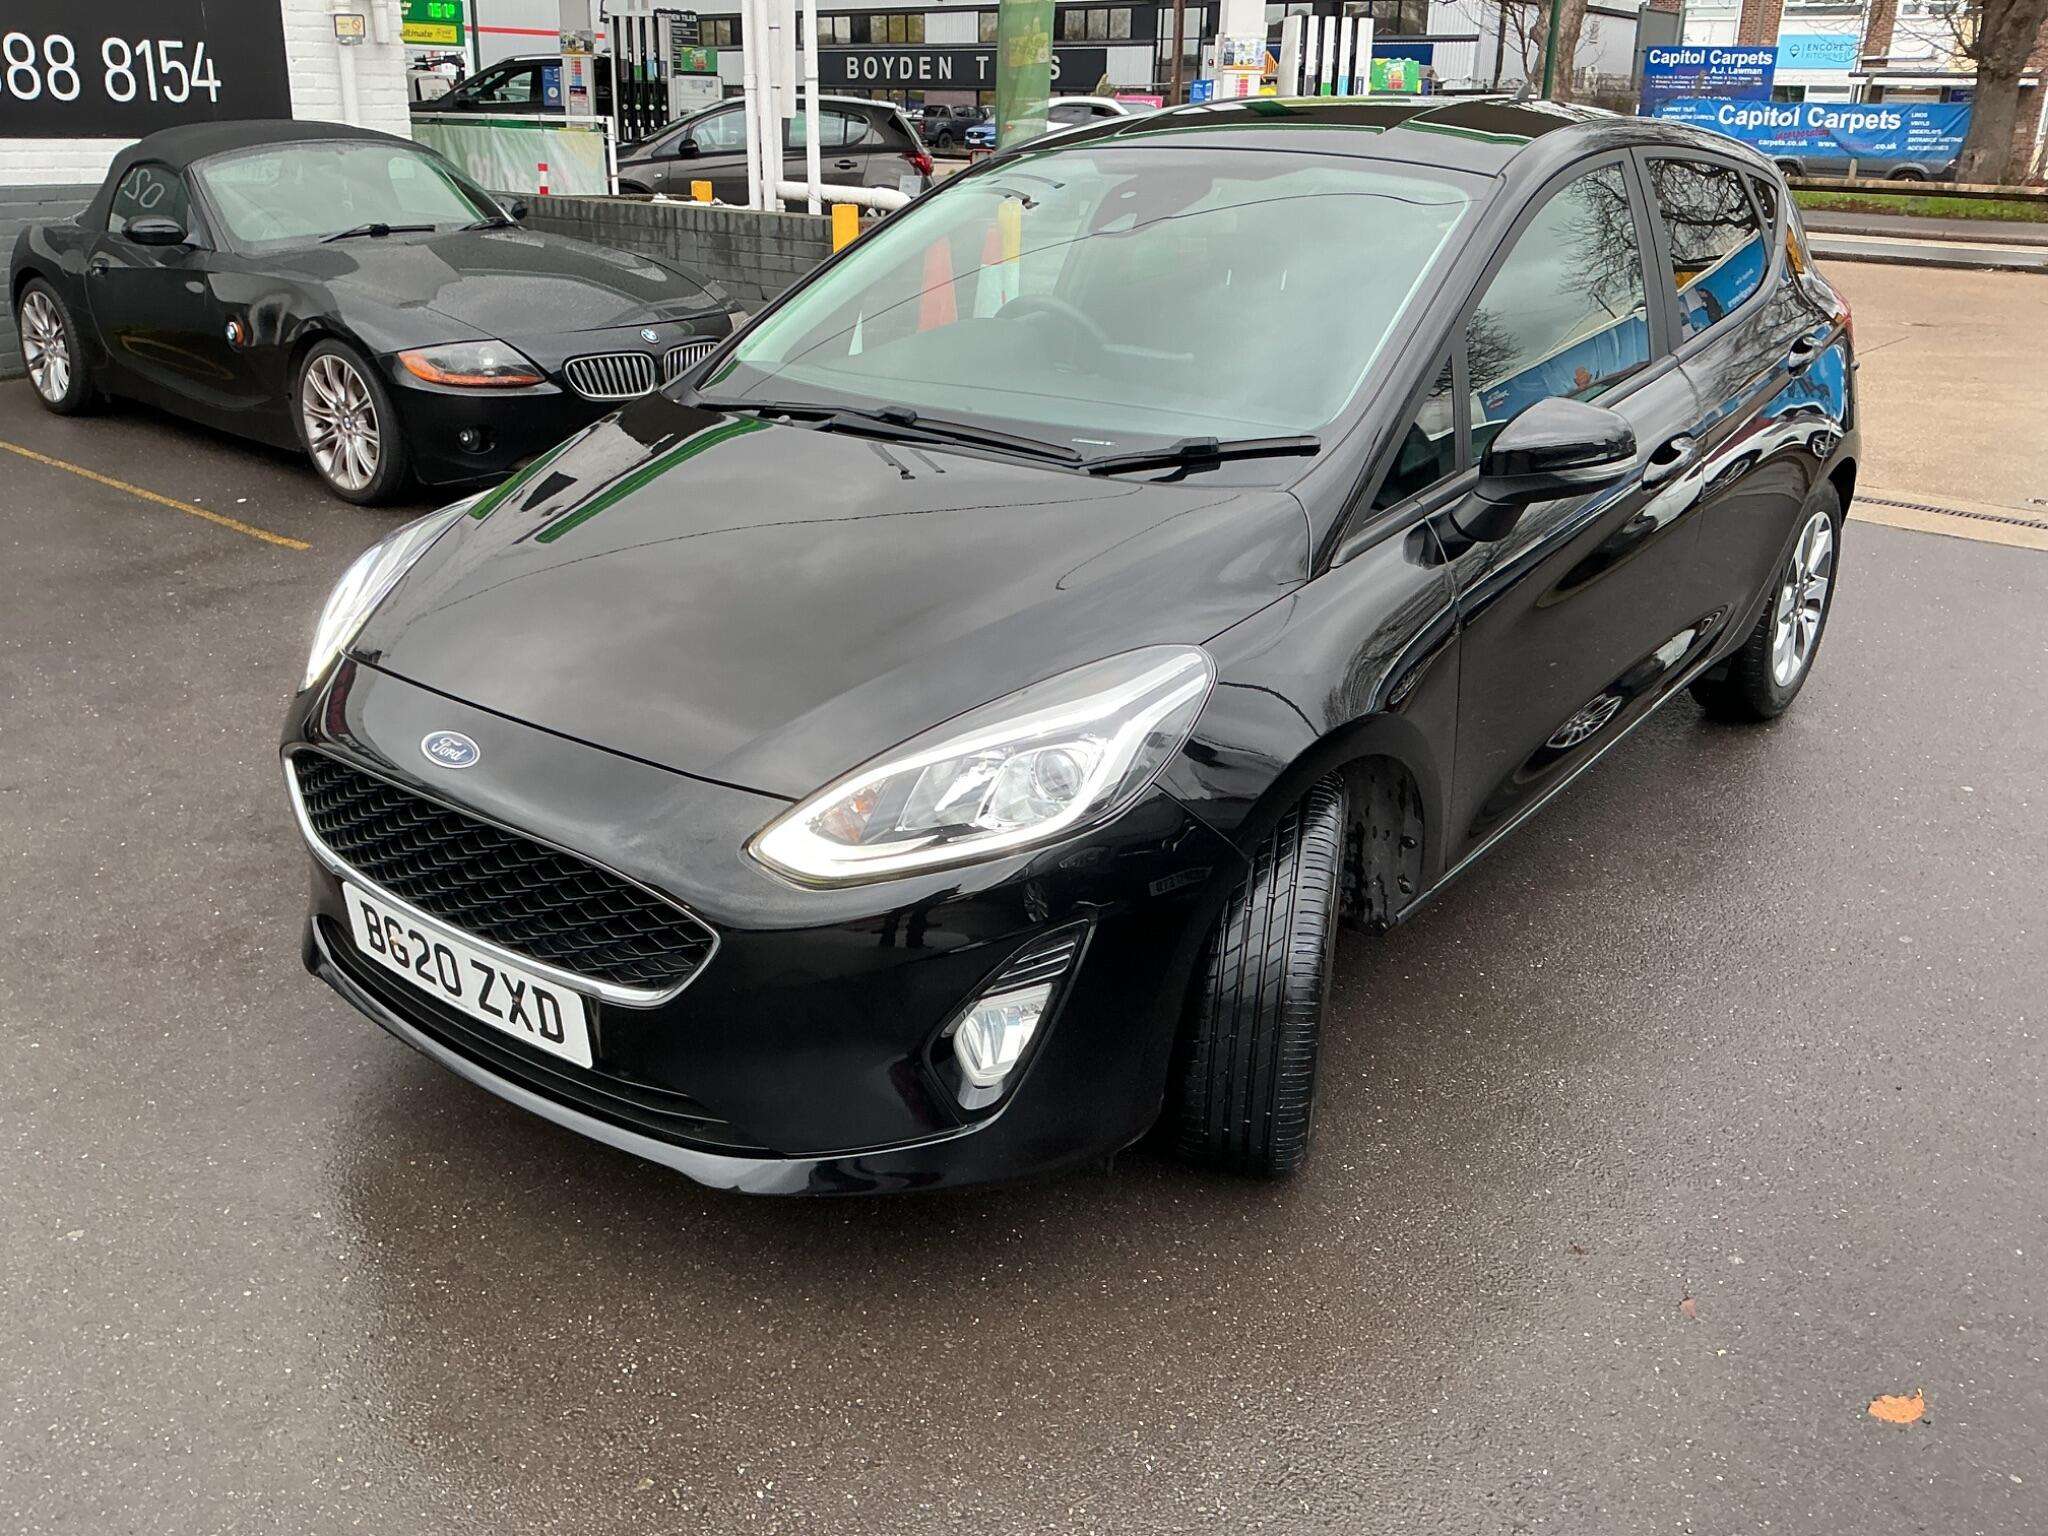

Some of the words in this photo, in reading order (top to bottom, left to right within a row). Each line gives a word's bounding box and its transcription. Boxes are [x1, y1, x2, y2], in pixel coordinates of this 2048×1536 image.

[1649, 49, 1706, 67] Capitol
[1709, 50, 1773, 68] Carpets
[1807, 43, 1845, 52] ENCORE
[101, 37, 222, 103] 8154
[846, 56, 953, 81] BOYDEN
[1727, 67, 1763, 75] Lawman
[1718, 104, 1800, 131] Capitol
[1807, 107, 1901, 133] Carpets
[432, 737, 468, 761] Ford
[360, 900, 463, 998] BG20
[469, 958, 566, 1044] ZXD
